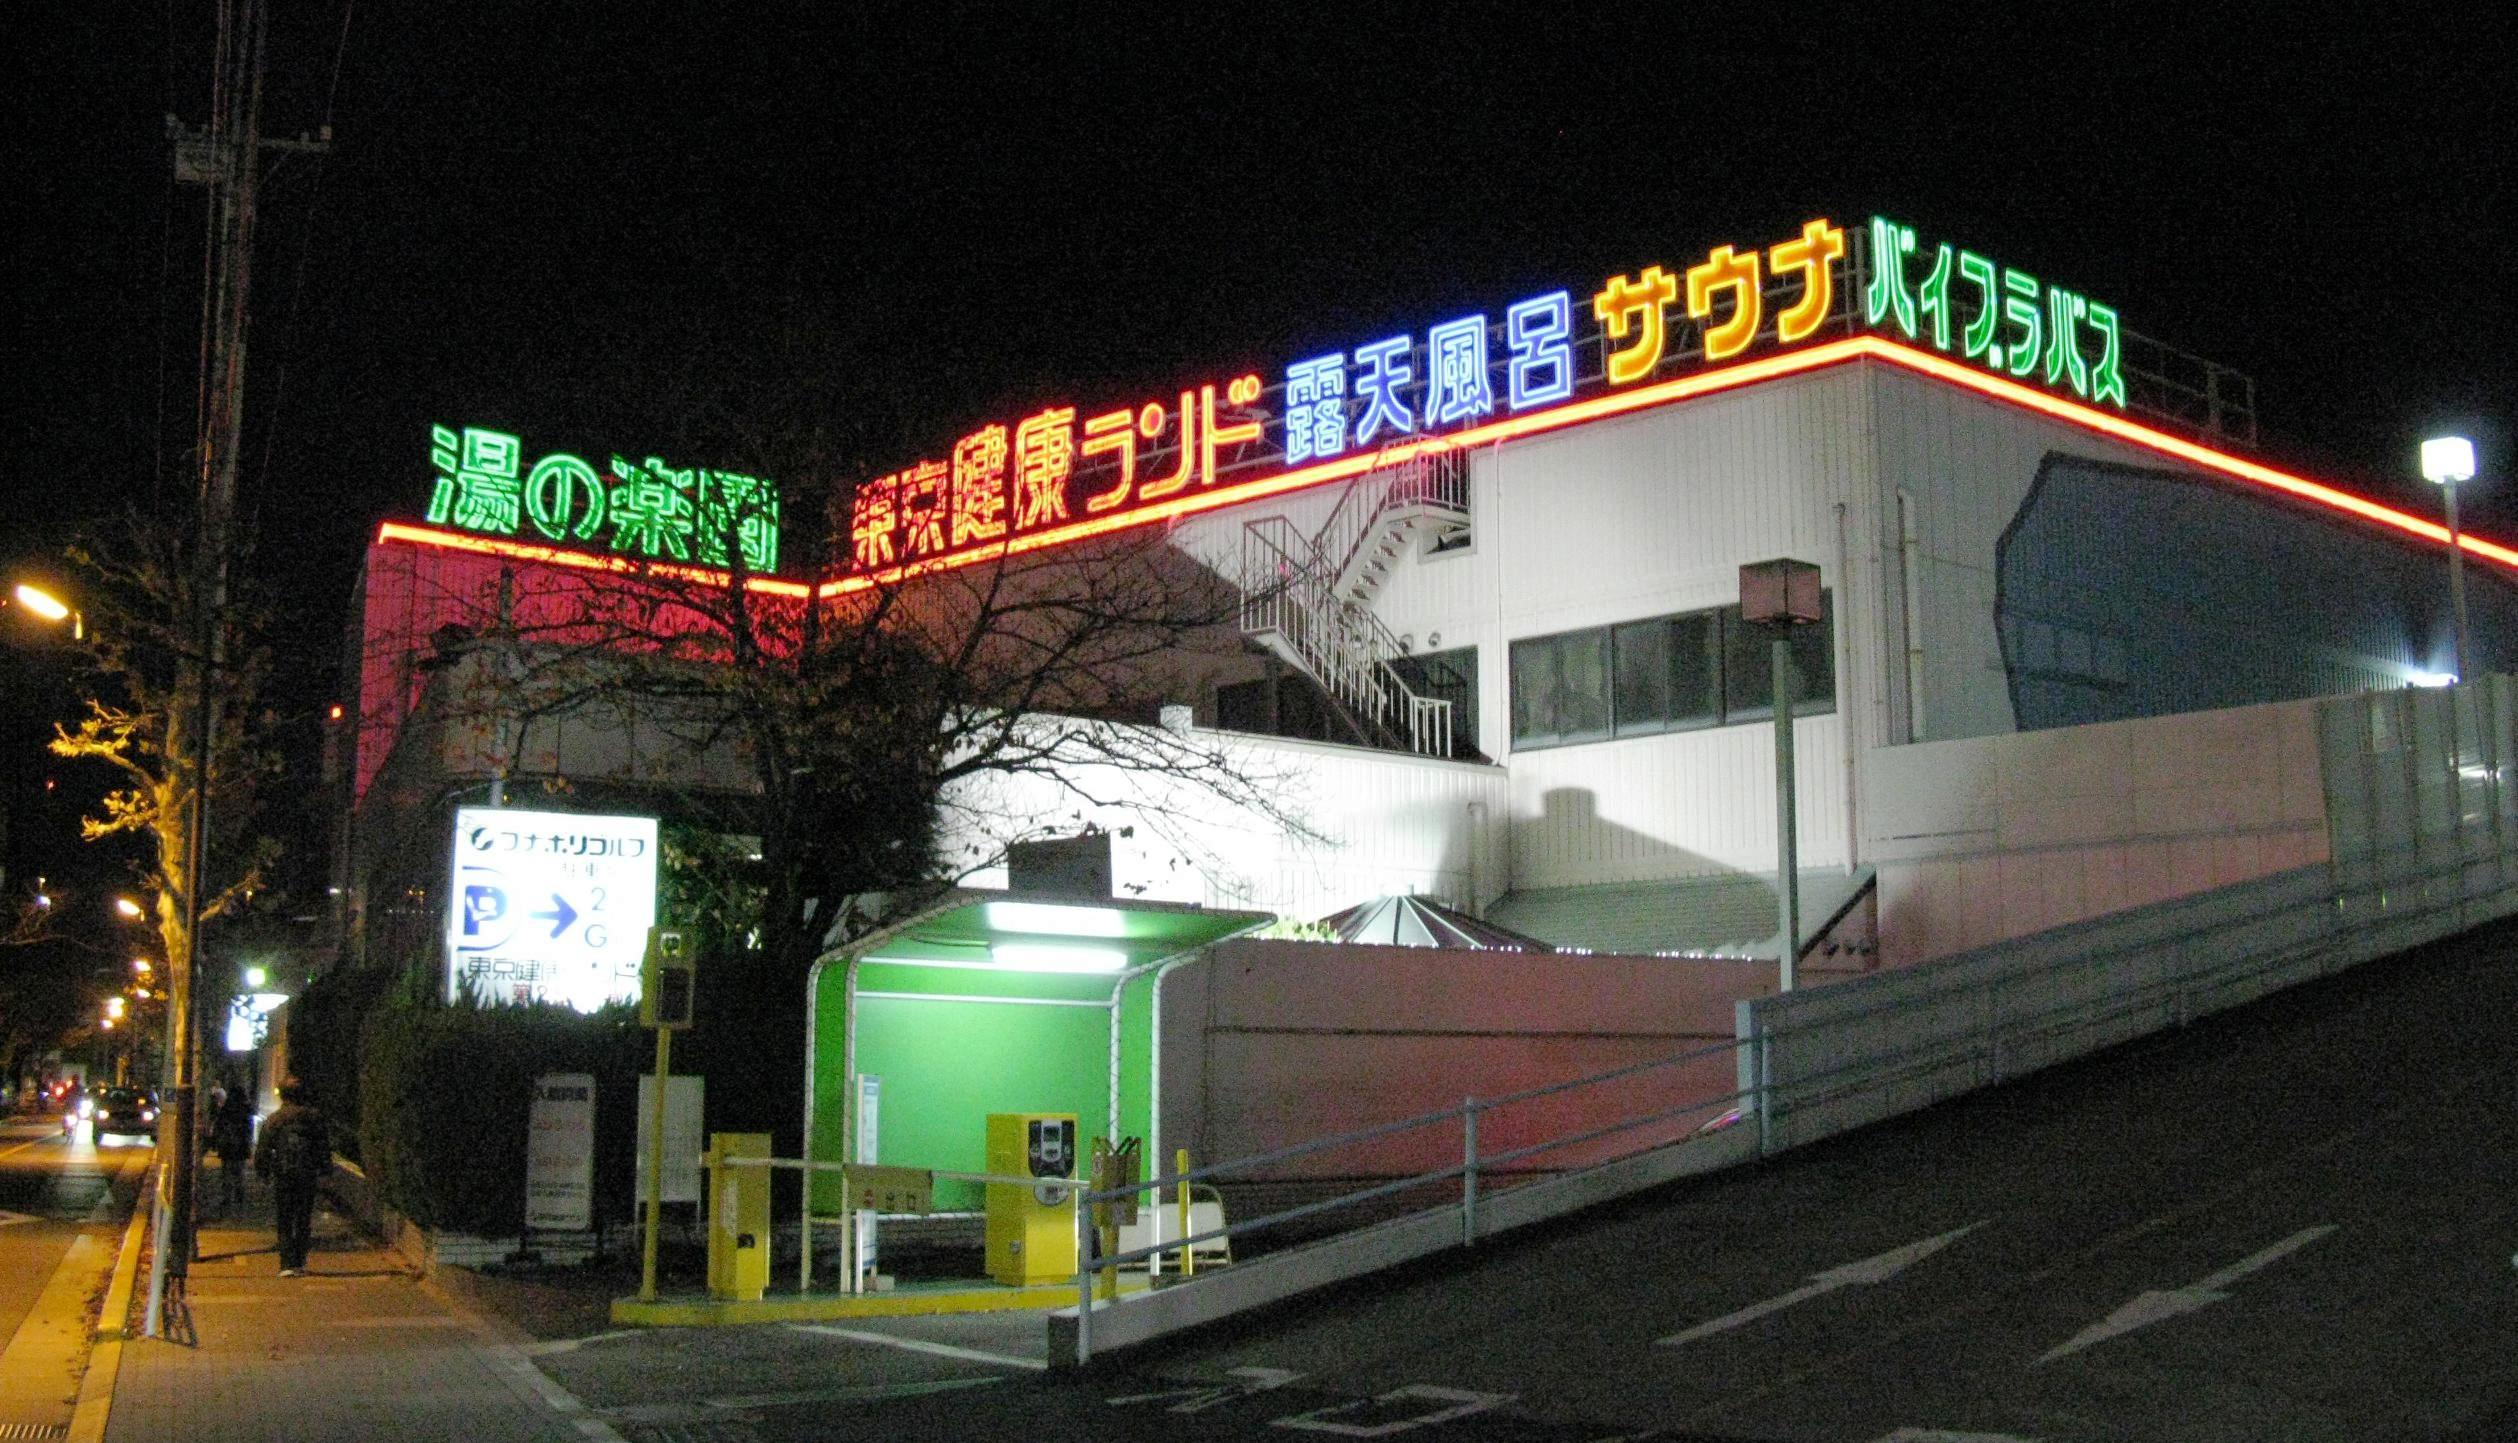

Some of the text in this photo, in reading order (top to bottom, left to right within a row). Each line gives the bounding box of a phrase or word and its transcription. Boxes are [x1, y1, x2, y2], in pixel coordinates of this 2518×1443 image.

[851, 218, 1845, 571] 東京健康ランド 露天風呂 サウナ
[1866, 215, 2126, 408] バイブラバス
[426, 422, 780, 574] 湯の楽園
